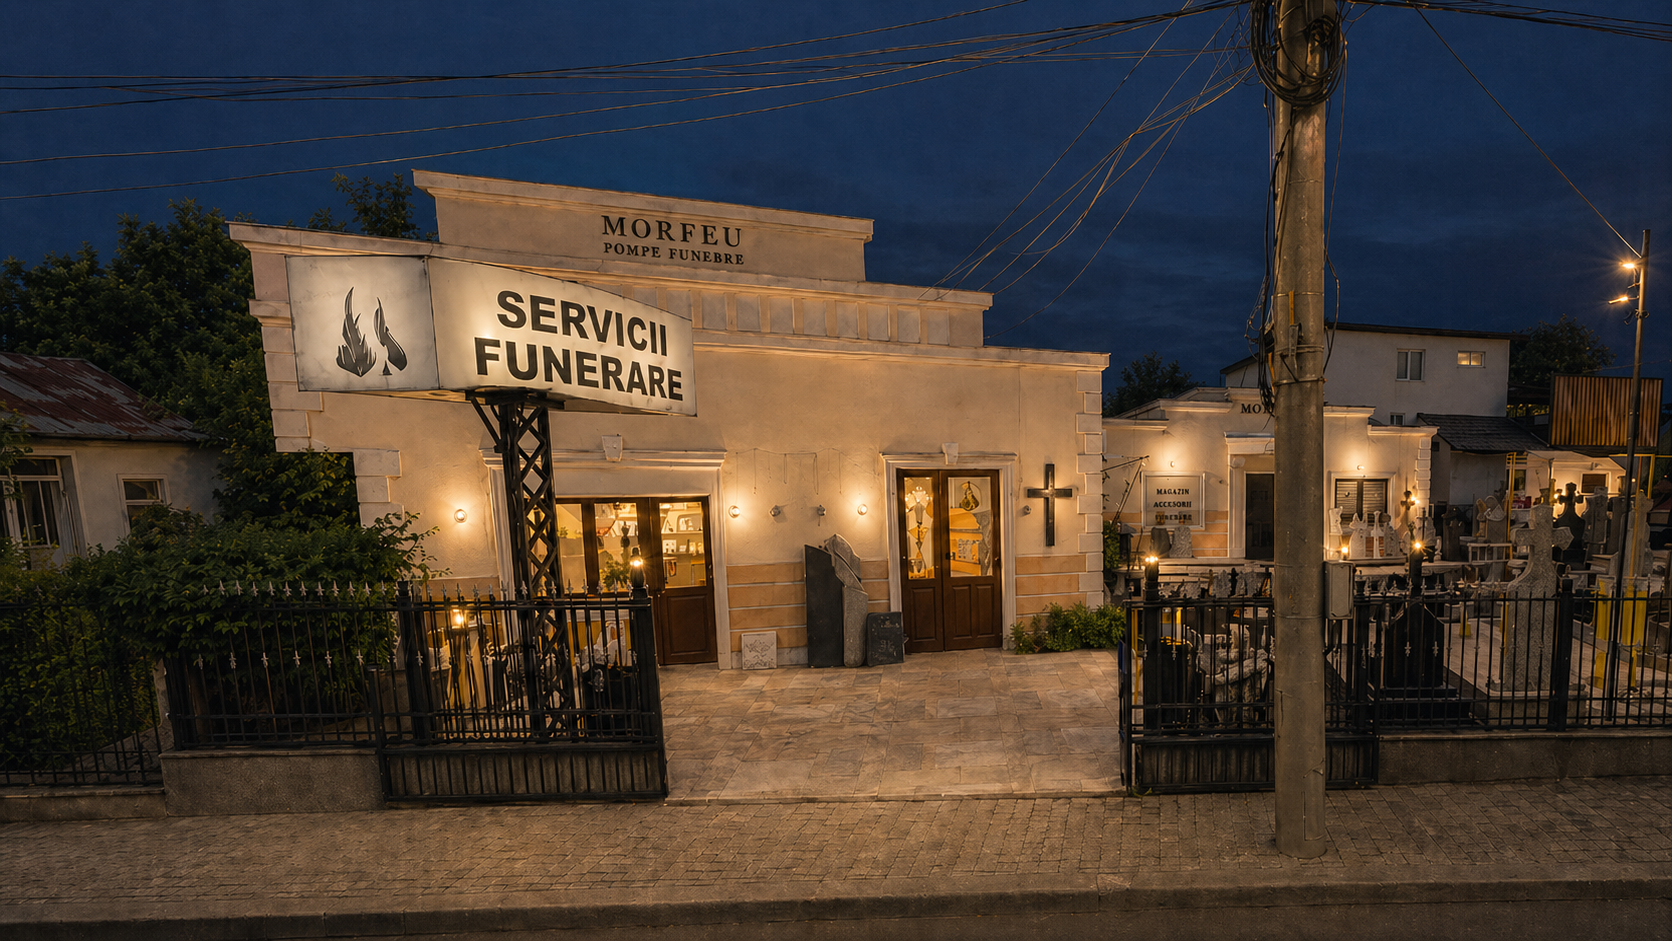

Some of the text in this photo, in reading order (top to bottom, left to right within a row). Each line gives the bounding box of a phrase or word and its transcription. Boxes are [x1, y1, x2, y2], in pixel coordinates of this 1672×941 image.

[601, 215, 742, 247] MORFEU
[603, 242, 745, 265] POMPE FUNEBRE
[497, 290, 667, 357] SERVICII
[474, 337, 683, 401] FUNERARE
